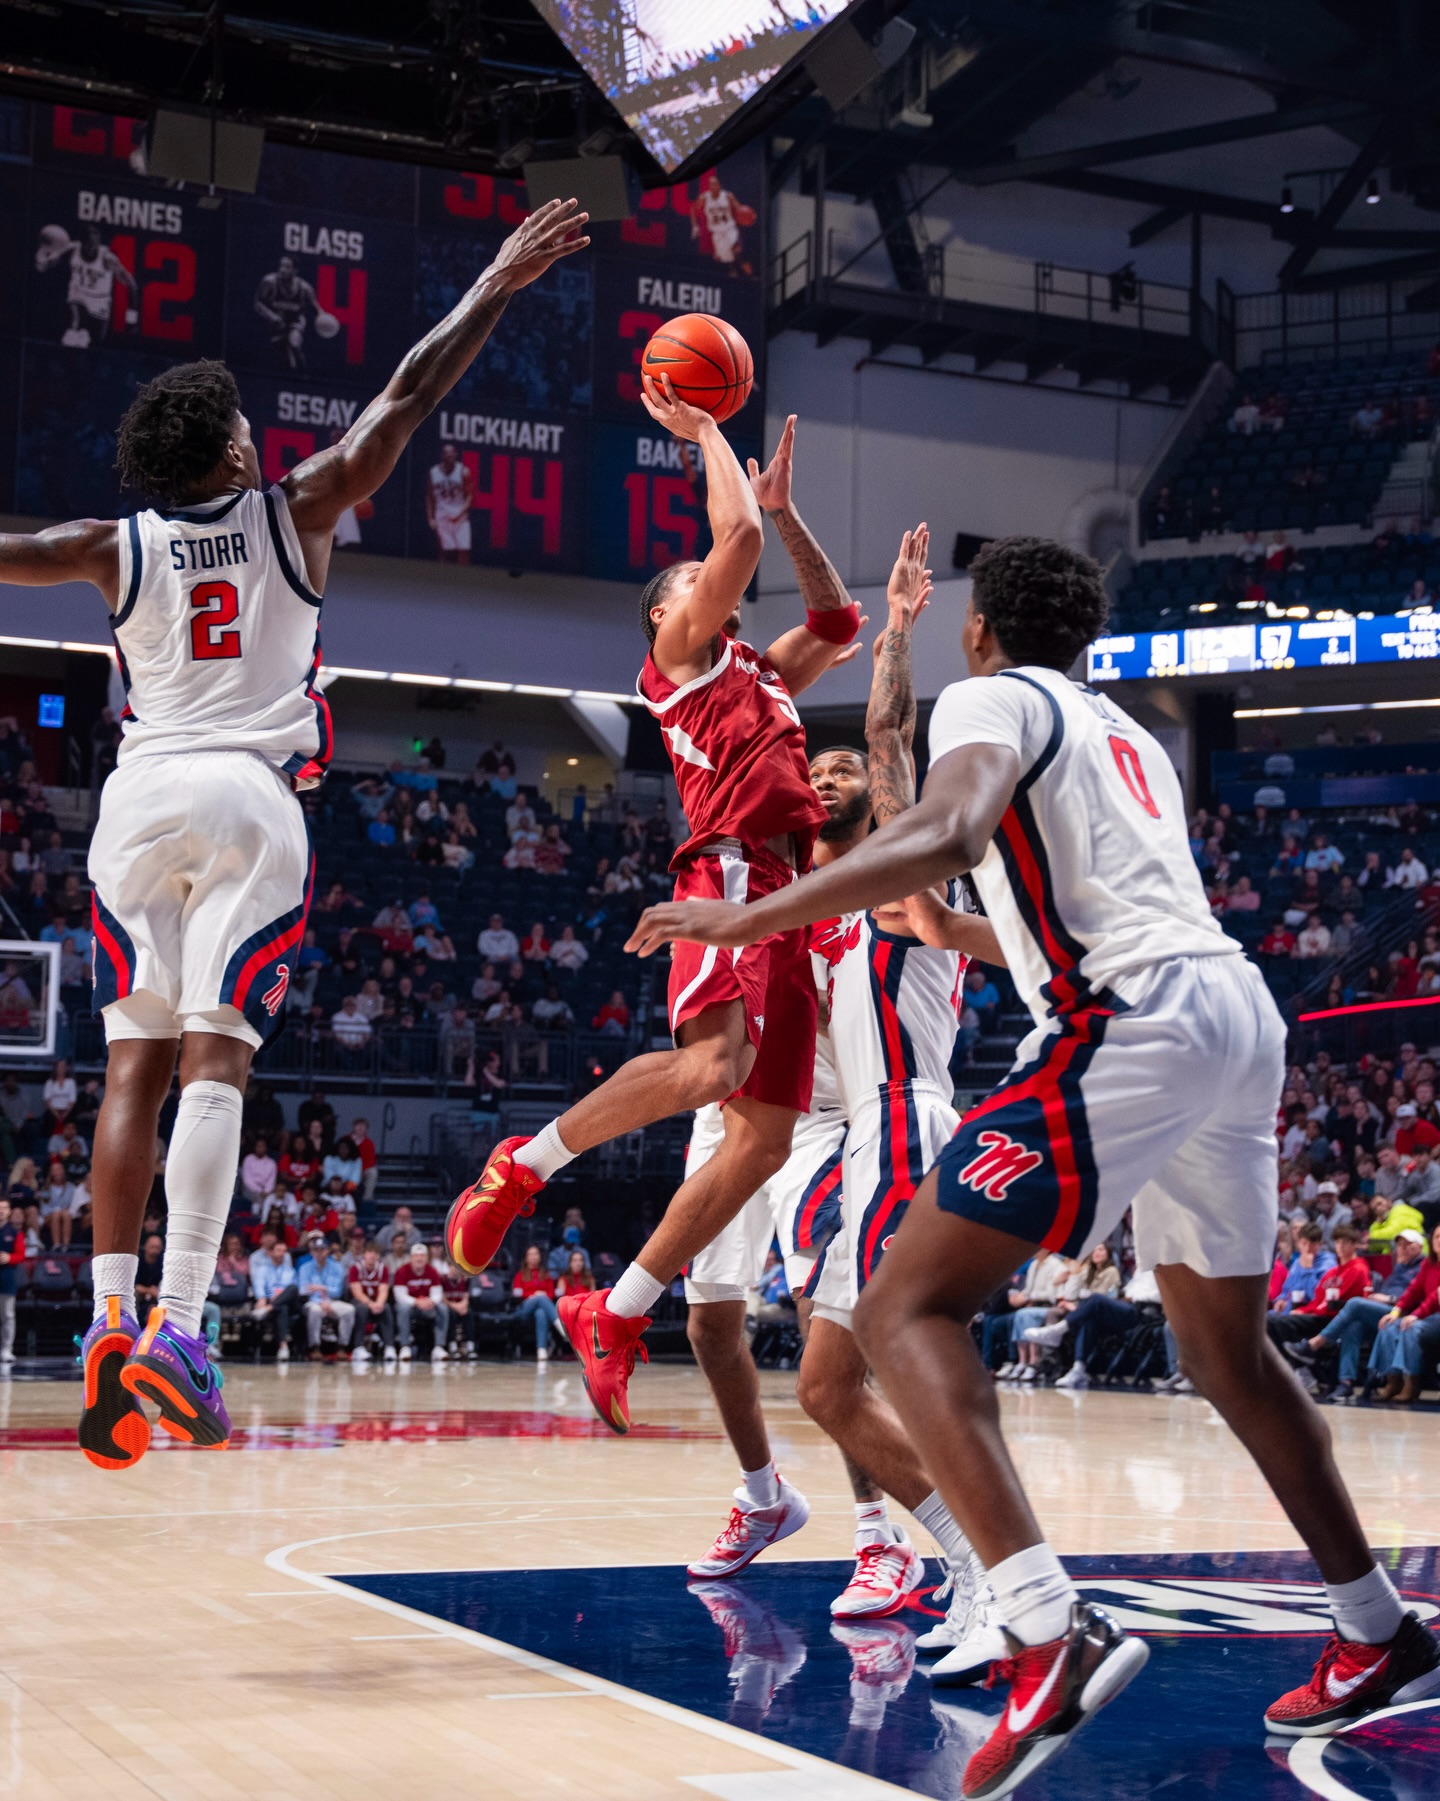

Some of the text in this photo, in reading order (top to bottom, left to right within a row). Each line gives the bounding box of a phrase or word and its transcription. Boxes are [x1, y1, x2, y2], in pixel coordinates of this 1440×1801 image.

[78, 190, 182, 234] BARNES
[284, 222, 364, 261] GLASS
[109, 235, 197, 342] 12
[317, 264, 367, 365] 4
[637, 277, 722, 315] FALERU
[278, 391, 358, 427] SESAY
[440, 411, 564, 453] LOCKHART
[462, 451, 563, 555] 44
[624, 473, 699, 569] 15
[169, 532, 249, 571] STORR
[190, 580, 242, 661] 2
[1108, 735, 1161, 819] 0
